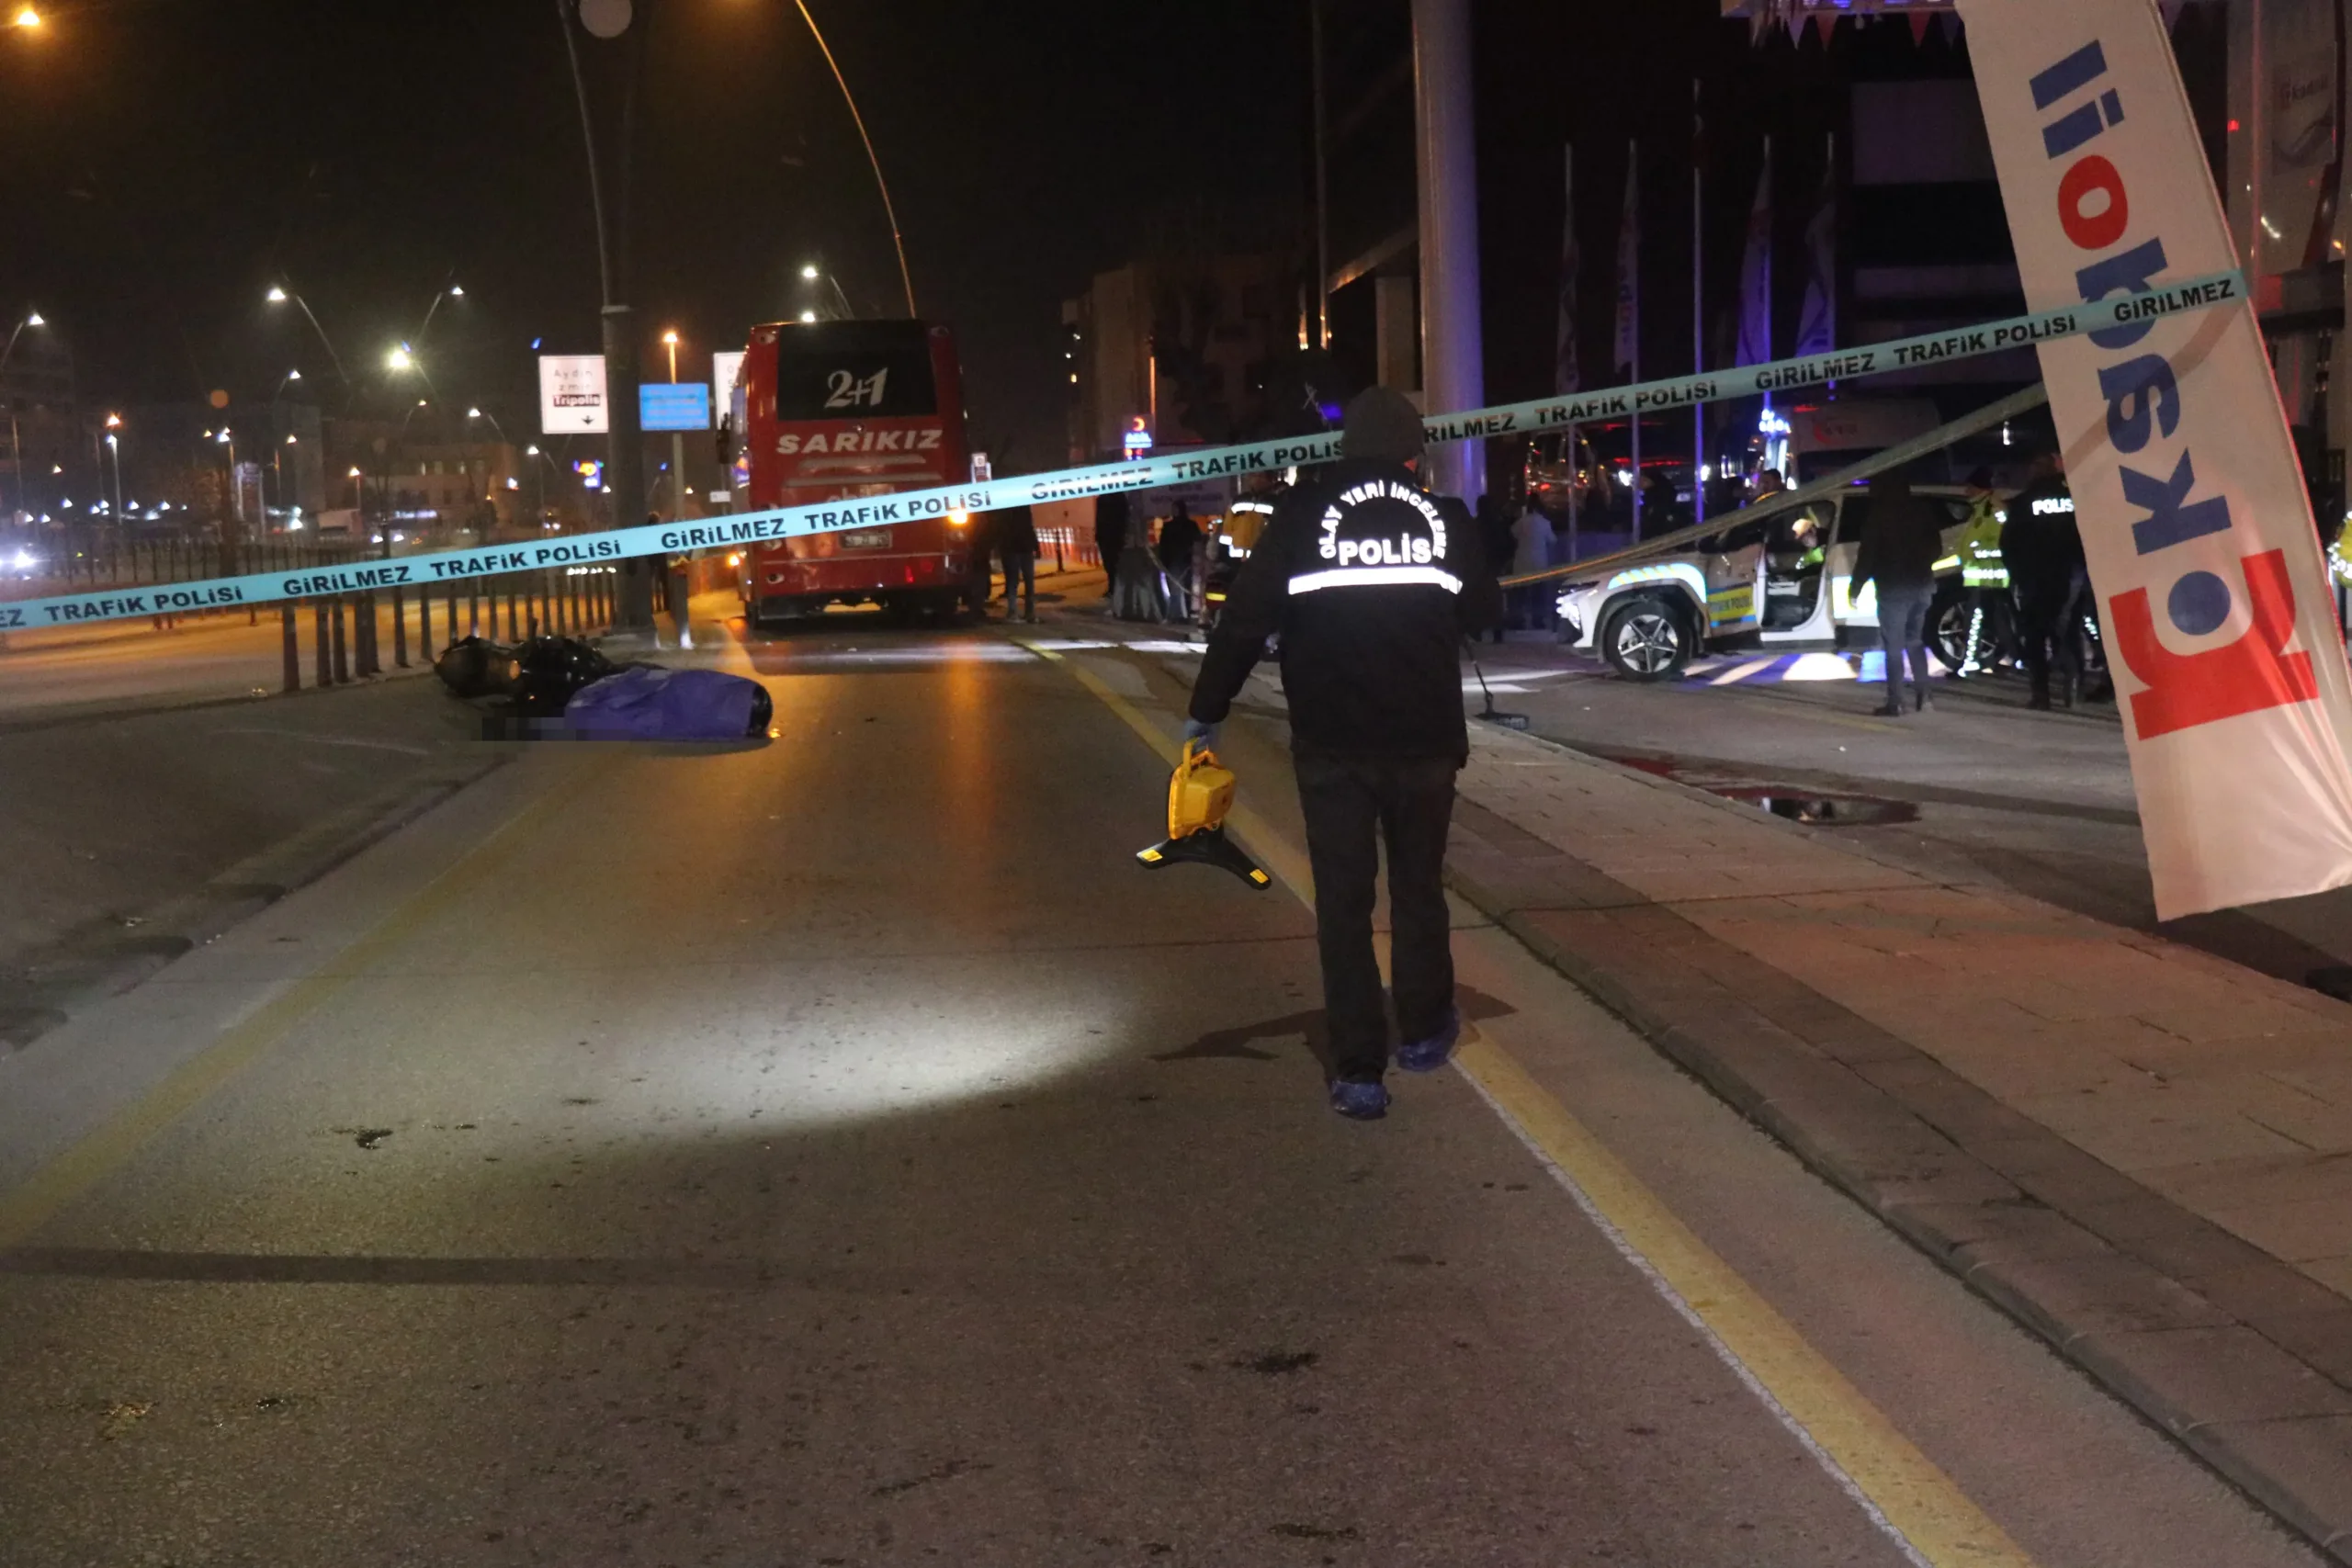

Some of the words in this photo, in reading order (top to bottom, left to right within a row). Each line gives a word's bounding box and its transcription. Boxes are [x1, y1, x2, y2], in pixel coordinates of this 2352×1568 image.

[1894, 332, 1986, 365] TRAFİK
[1994, 314, 2076, 345] POLİSİ
[2114, 278, 2234, 321] GİRİLMEZ
[554, 395, 600, 407] Tripolis
[824, 367, 888, 409] 2+1
[1534, 395, 1628, 424] TRAFİK
[1634, 379, 1717, 409] POLİSİ
[1755, 352, 1875, 389] GİRİLMEZ
[775, 429, 944, 455] SARIKIZ
[1172, 449, 1266, 479] TRAFİK
[1273, 439, 1344, 465] POLİS
[1424, 412, 1518, 444] RİLMEZ
[1031, 466, 1154, 500] GİRİLMEZ
[805, 502, 899, 530] TRAFİK
[909, 491, 992, 517] POLİSİ
[1318, 505, 1343, 559] OLAY
[1340, 479, 1385, 507] YERİ
[1389, 481, 1447, 559] İNCELEME
[430, 551, 529, 579] TRAFİK
[537, 539, 622, 565] POLİSİ
[661, 517, 787, 549] GİRİLMEZ
[1338, 533, 1432, 566] POLİS
[44, 595, 144, 623] TRAFİK
[153, 585, 243, 610] POLİSİ
[282, 566, 413, 596] GİRİLMEZ
